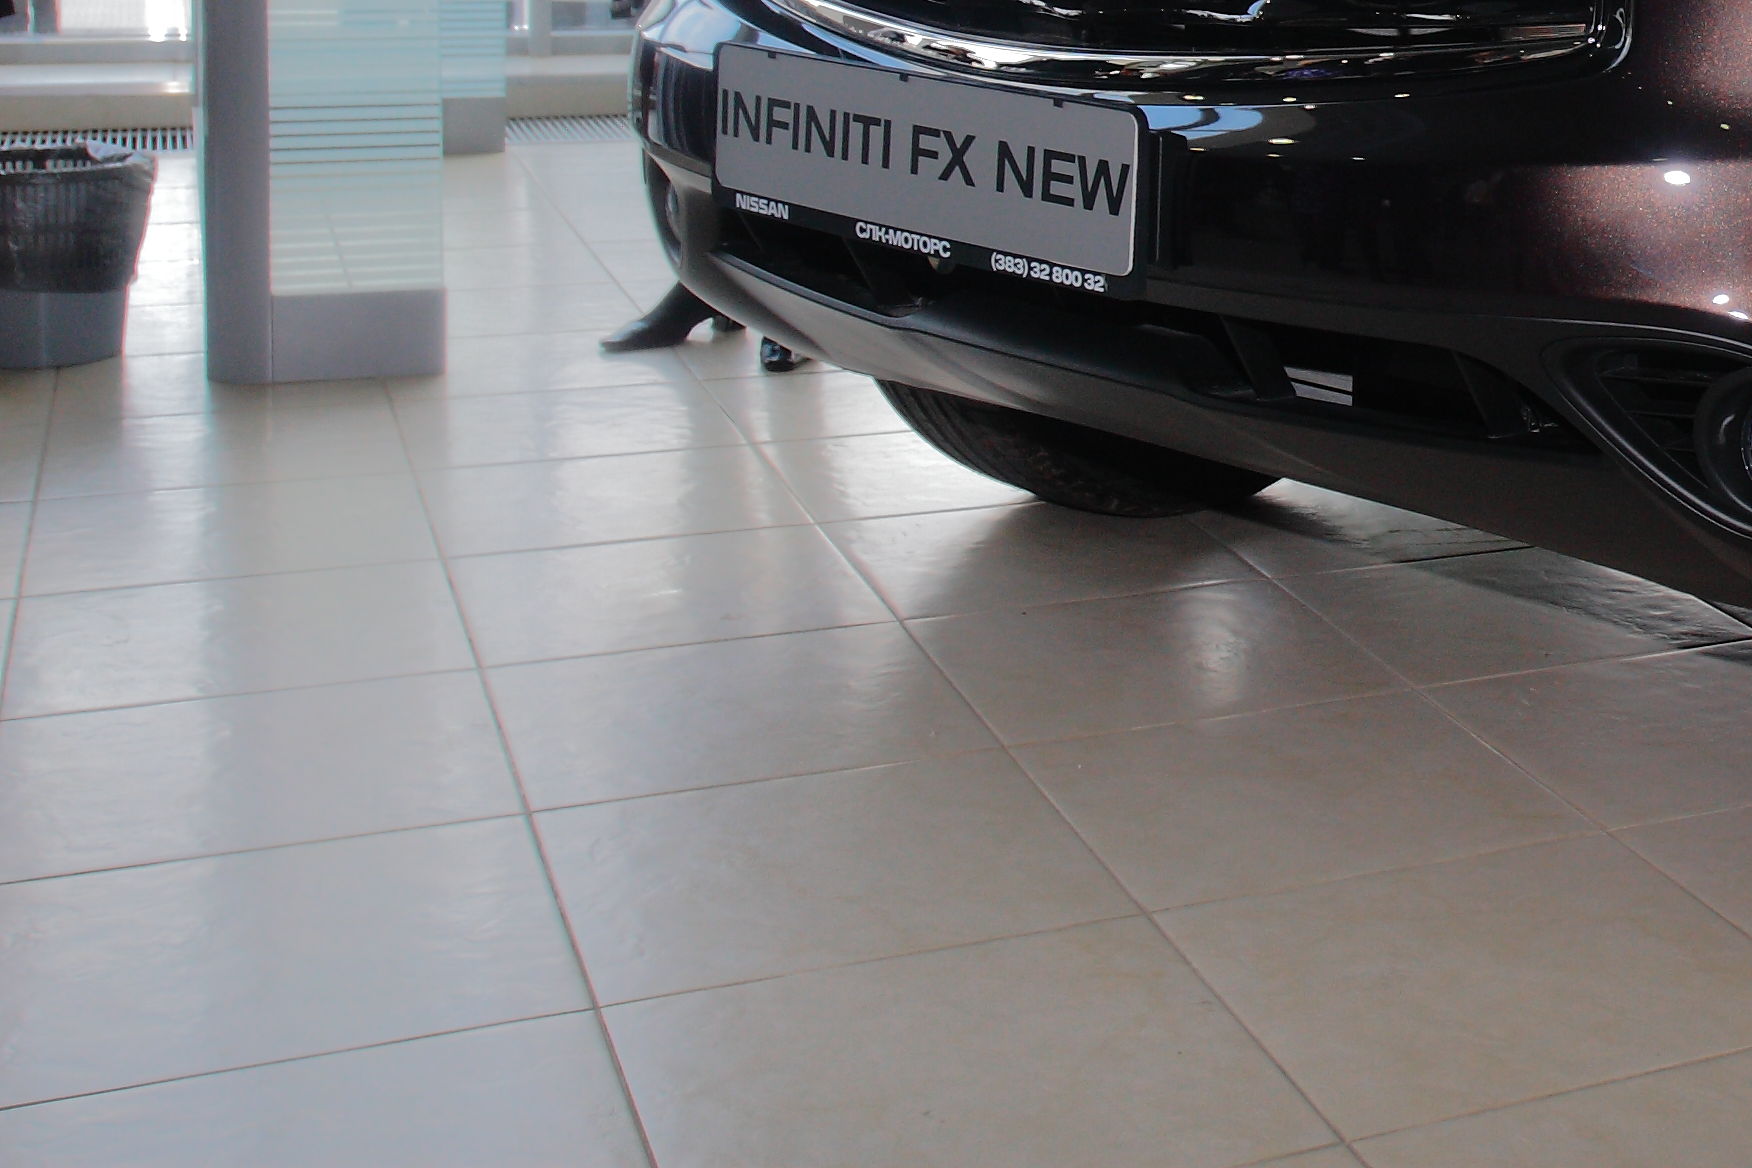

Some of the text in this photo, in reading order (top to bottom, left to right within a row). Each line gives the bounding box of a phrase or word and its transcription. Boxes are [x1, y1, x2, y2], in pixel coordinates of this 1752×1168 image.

[721, 88, 1130, 216] INFINITI FX NEW
[735, 193, 789, 220] NISSAN
[855, 221, 951, 259] СЛК-МОТОРС
[991, 252, 1105, 292] (383) 32 800 32
